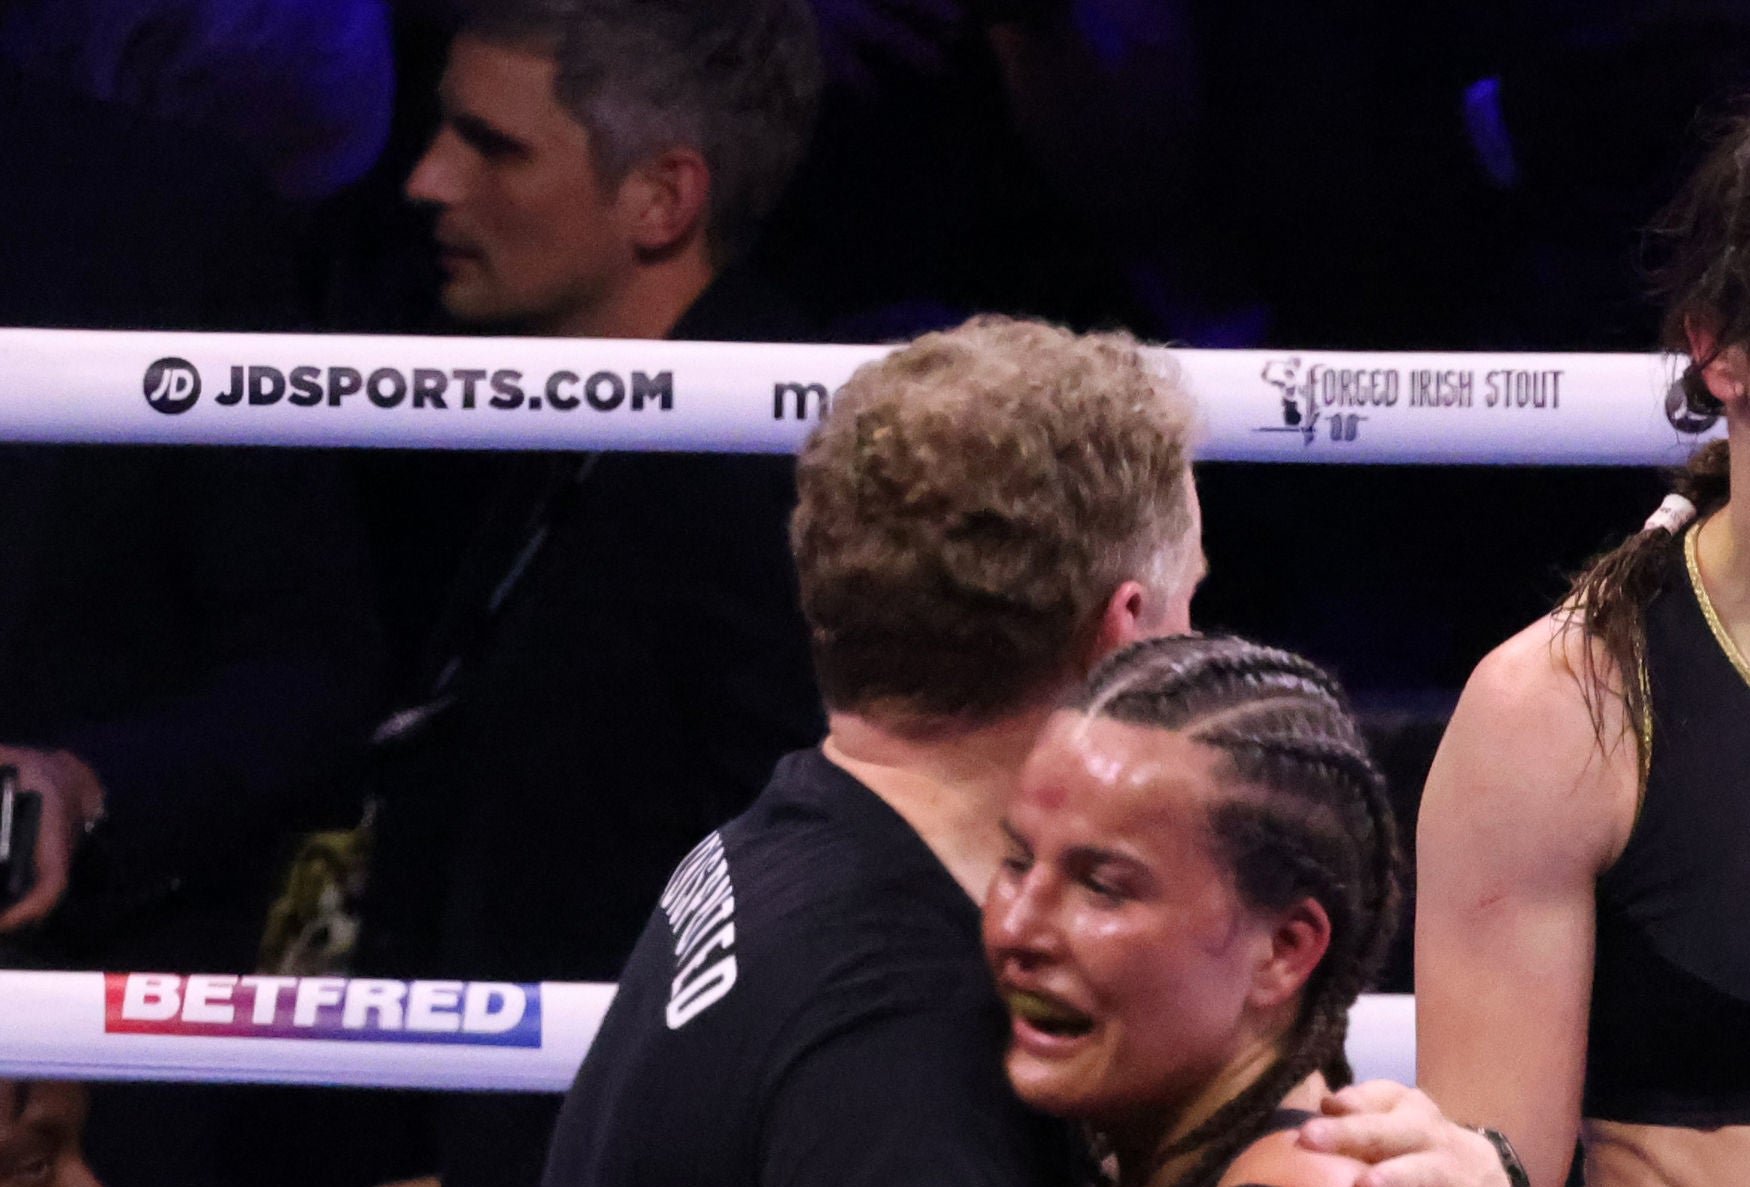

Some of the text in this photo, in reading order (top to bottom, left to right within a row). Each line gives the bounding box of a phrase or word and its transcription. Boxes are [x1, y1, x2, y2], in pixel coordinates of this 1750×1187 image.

[215, 365, 675, 412] JDSPORTS.COM
[1409, 368, 1474, 409] IRISH
[1485, 369, 1565, 409] STOUT
[121, 973, 527, 1034] BETFRED
